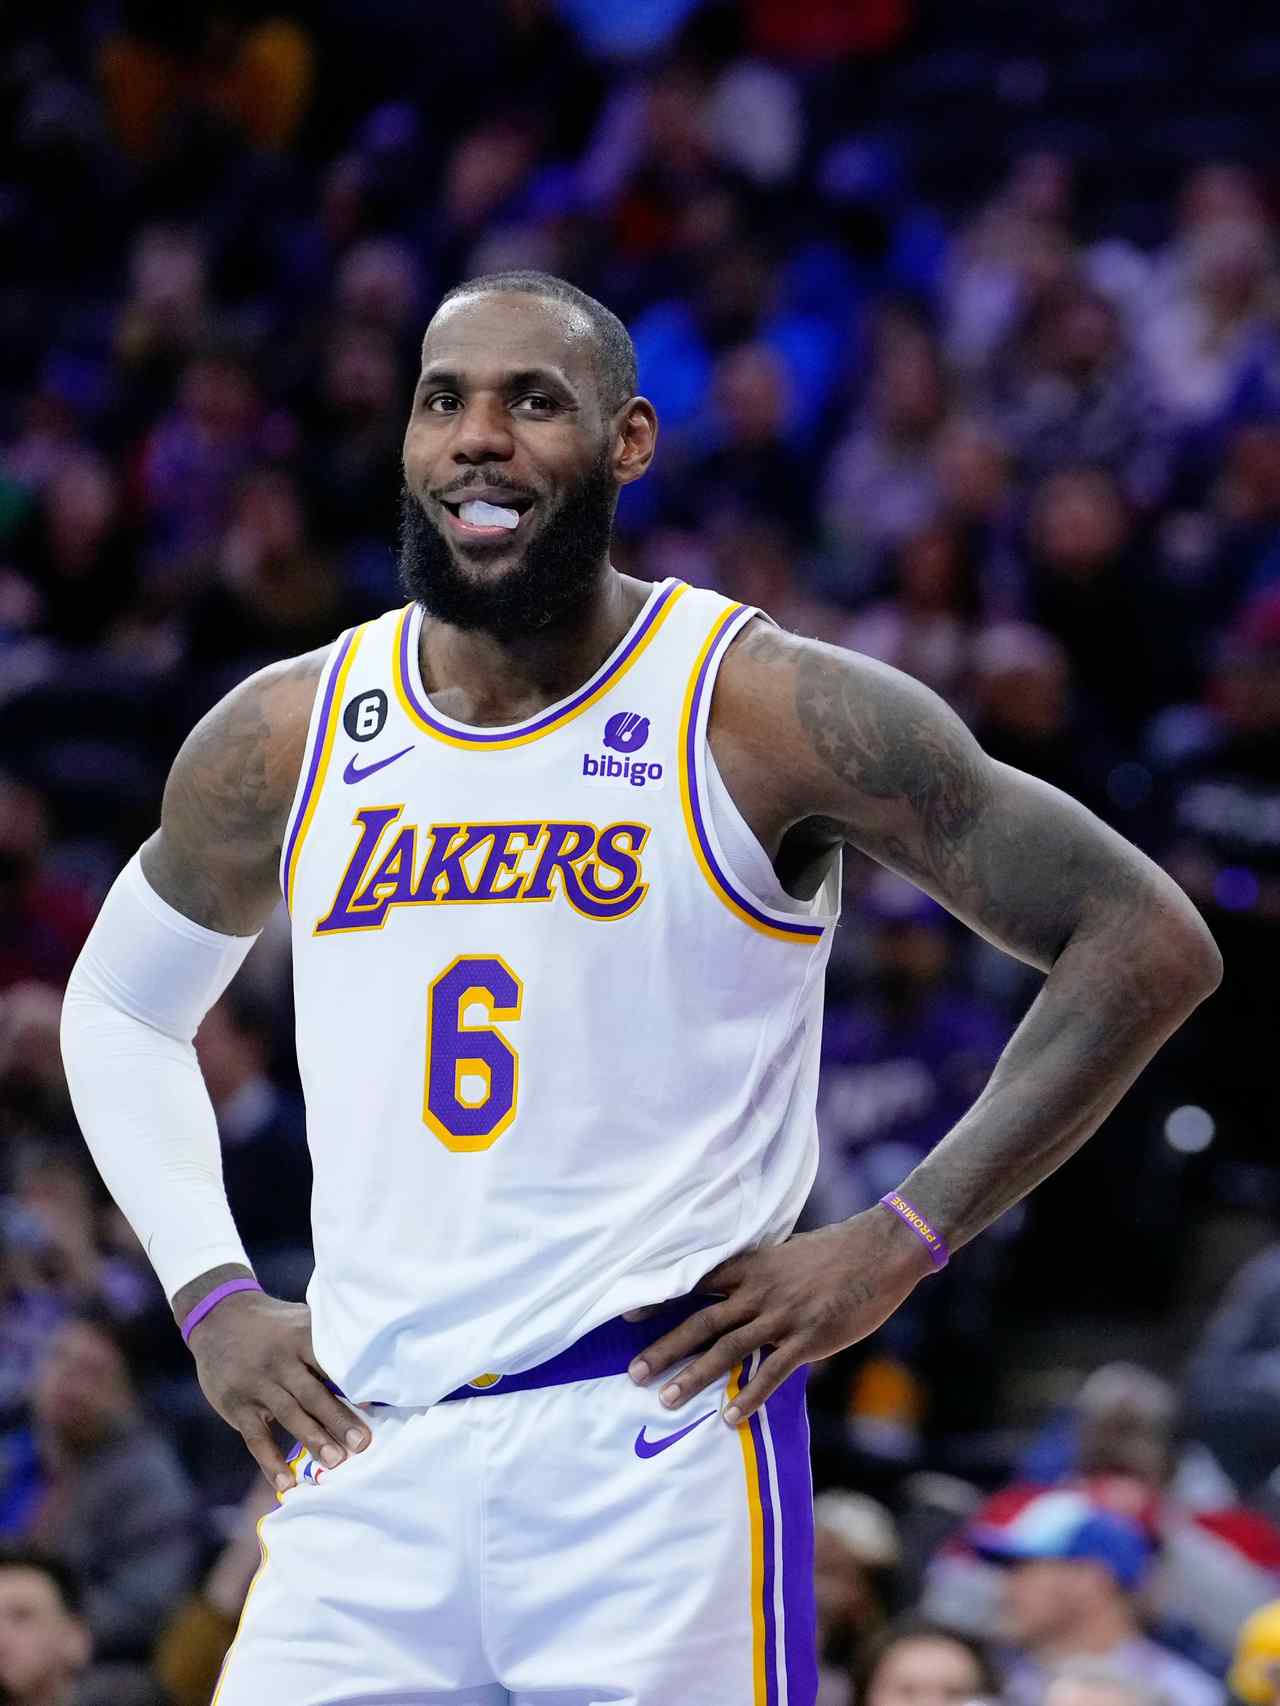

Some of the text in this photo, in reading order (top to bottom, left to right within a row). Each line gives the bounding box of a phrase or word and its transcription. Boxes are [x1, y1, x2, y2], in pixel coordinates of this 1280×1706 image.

[354, 694, 382, 737] 6
[582, 753, 663, 786] bibigo
[313, 804, 652, 936] LAKERS
[422, 953, 524, 1153] 6
[891, 1196, 937, 1243] PROMISE
